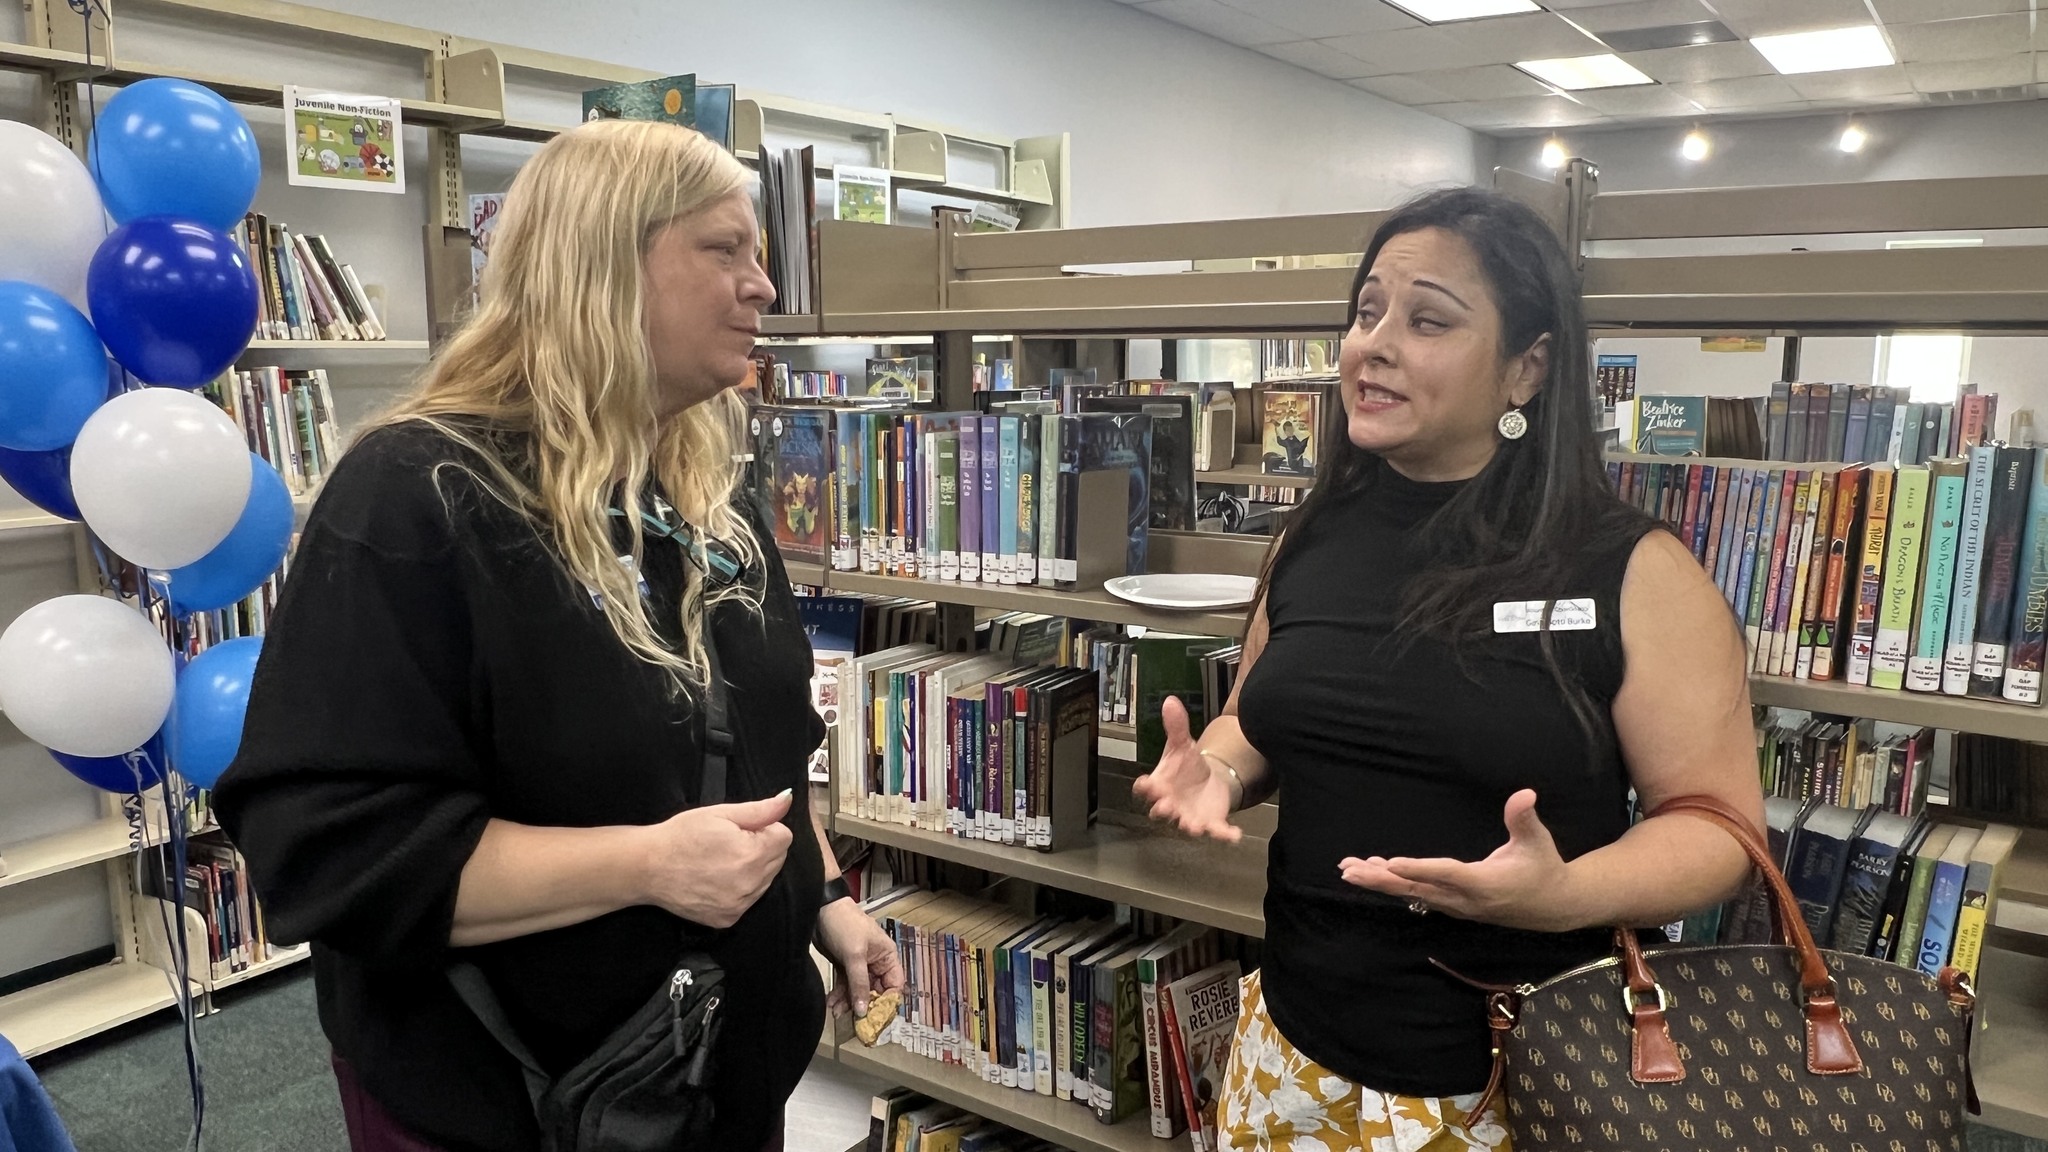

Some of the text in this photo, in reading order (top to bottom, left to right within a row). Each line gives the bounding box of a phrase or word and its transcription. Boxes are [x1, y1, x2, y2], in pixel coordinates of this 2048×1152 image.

[295, 98, 335, 110] Juvenile
[338, 103, 391, 117] Non-Fiction
[1642, 400, 1684, 416] Beatrice
[1645, 414, 1686, 431] Zinker
[1962, 454, 1988, 599] THE SECRET OF THE INDIAN
[1813, 762, 1824, 796] SWIND
[1918, 938, 1942, 979] SOA
[1190, 980, 1231, 1011] ROSIE
[1146, 1007, 1157, 1047] CIRCUS
[1188, 995, 1239, 1032] REVERE
